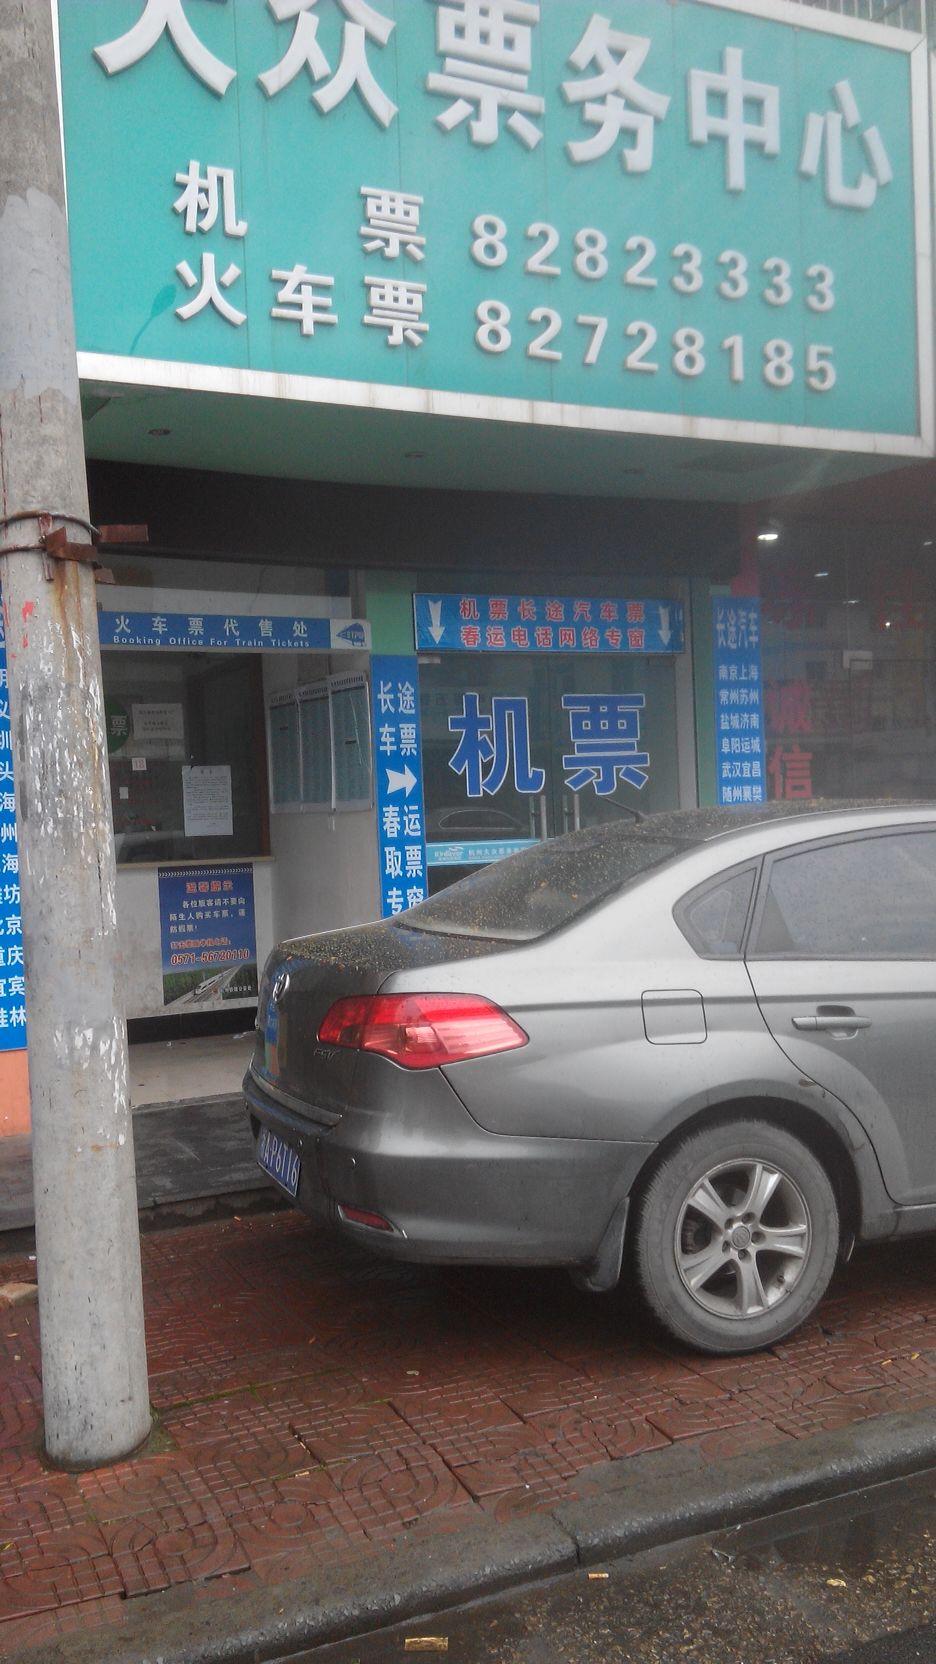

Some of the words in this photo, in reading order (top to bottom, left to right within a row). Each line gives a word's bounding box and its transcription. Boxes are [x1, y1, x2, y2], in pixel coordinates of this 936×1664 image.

[471, 213, 835, 312] 82823333
[175, 252, 430, 347] 火车票
[475, 300, 836, 391] 82728185
[459, 598, 645, 622] 机票长途汽车票
[114, 614, 309, 638] 火车票代售处
[460, 626, 645, 649] 春运电话网络专窗
[113, 635, 161, 646] Booking
[169, 637, 204, 646] Office
[210, 638, 228, 646] For
[235, 638, 264, 647] Train
[271, 639, 310, 648] Tickets
[718, 664, 759, 680] 南京上海
[377, 680, 416, 715] 长途
[719, 689, 760, 705] 常州苏州
[720, 713, 760, 730] 盐城济南
[379, 723, 418, 756] 车票
[448, 692, 649, 797] 机票
[721, 737, 761, 754] 阜阳运城
[722, 761, 762, 778] 武汉宜昌
[382, 804, 421, 838] 春运
[384, 844, 423, 879] 取票
[0, 884, 20, 905] 坊
